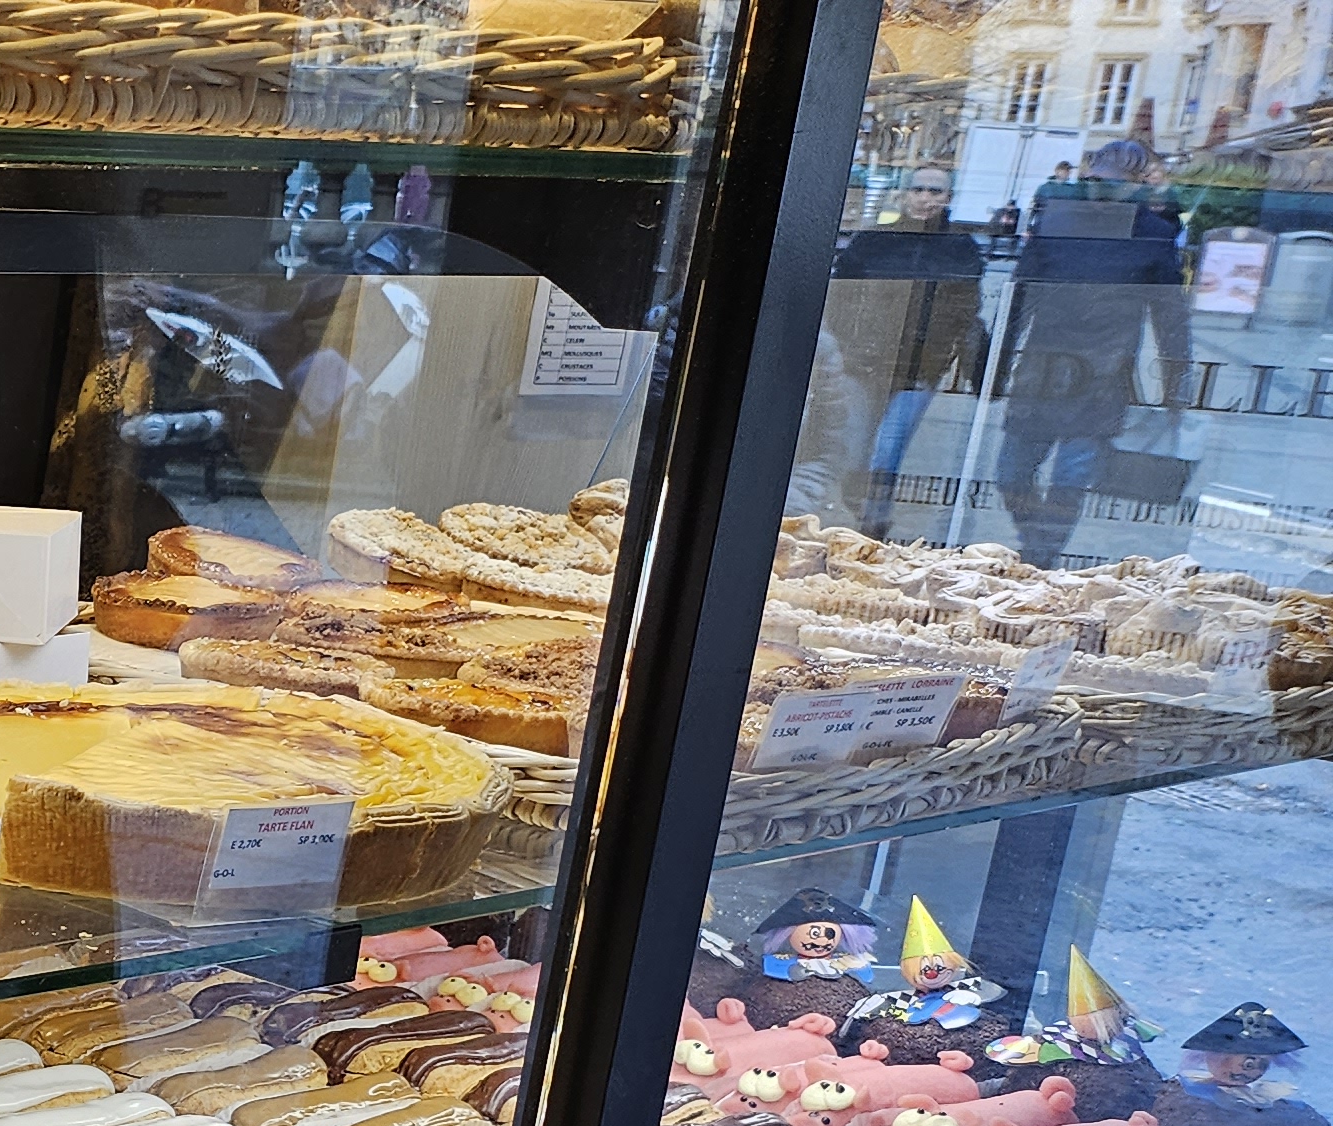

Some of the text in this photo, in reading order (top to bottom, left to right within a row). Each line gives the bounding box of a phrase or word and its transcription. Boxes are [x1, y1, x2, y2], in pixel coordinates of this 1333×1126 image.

[895, 716, 937, 728] SP 3,50€
[273, 806, 310, 817] PORTION
[258, 820, 315, 833] TARTE FLAN
[231, 838, 263, 850] E 2,70€
[297, 835, 310, 845] SP
